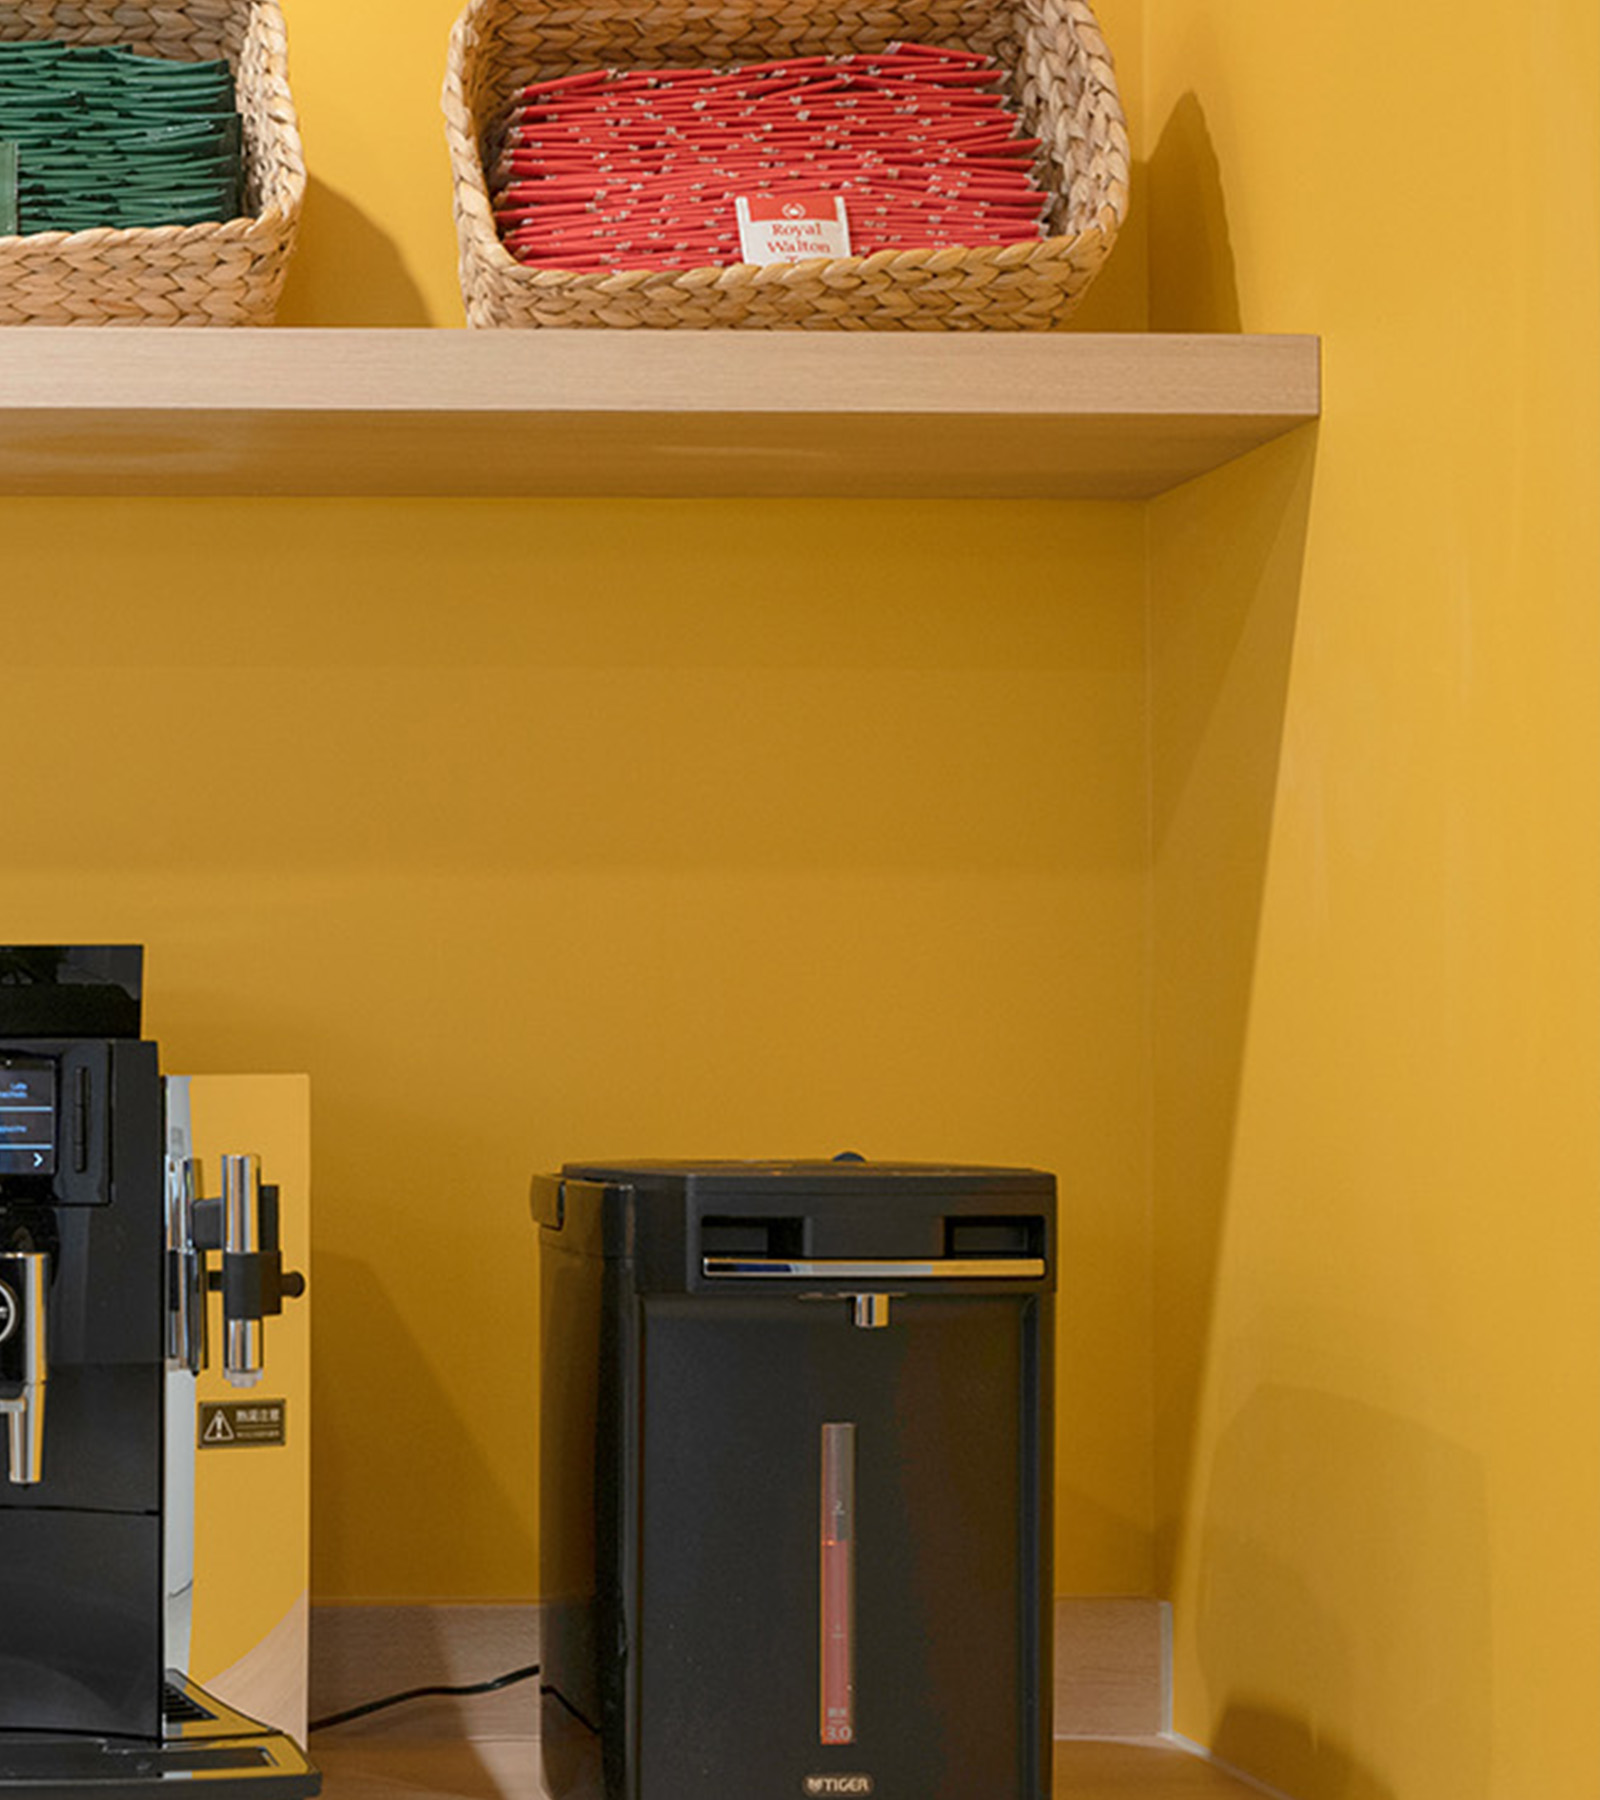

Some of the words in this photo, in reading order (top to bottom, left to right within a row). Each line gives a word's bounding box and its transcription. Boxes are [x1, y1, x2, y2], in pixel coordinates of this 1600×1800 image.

[772, 222, 823, 237] Royal
[766, 240, 831, 253] Walton
[824, 1777, 869, 1792] TIGER
